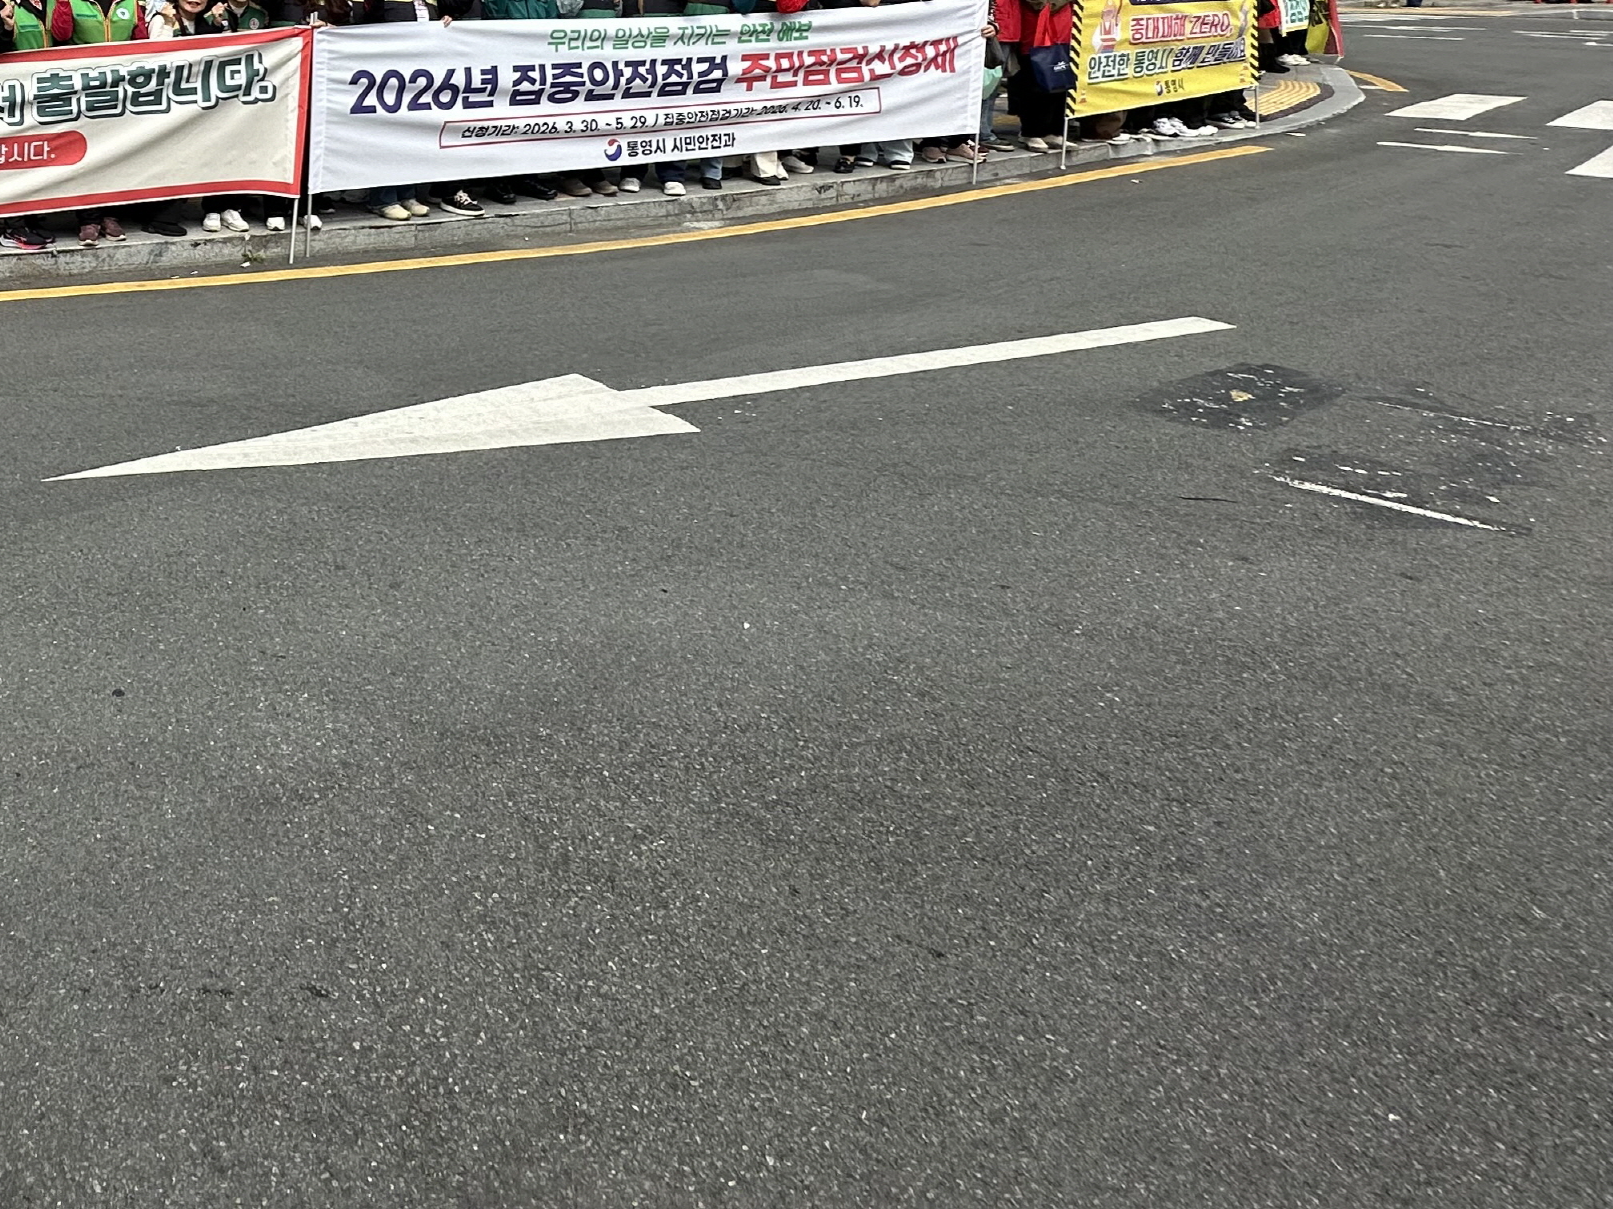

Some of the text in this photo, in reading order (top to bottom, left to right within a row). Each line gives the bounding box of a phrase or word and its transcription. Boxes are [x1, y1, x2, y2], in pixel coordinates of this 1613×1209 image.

[548, 22, 775, 52] 우리의 일상을 지키는 안전
[1130, 15, 1188, 43] 중대재해
[348, 36, 959, 115] 2026년 집중안전점검 주민점검신청제
[1088, 53, 1131, 83] 안전한
[32, 51, 276, 125] 출발합니다.
[626, 133, 736, 158] 통영시 시민안전과
